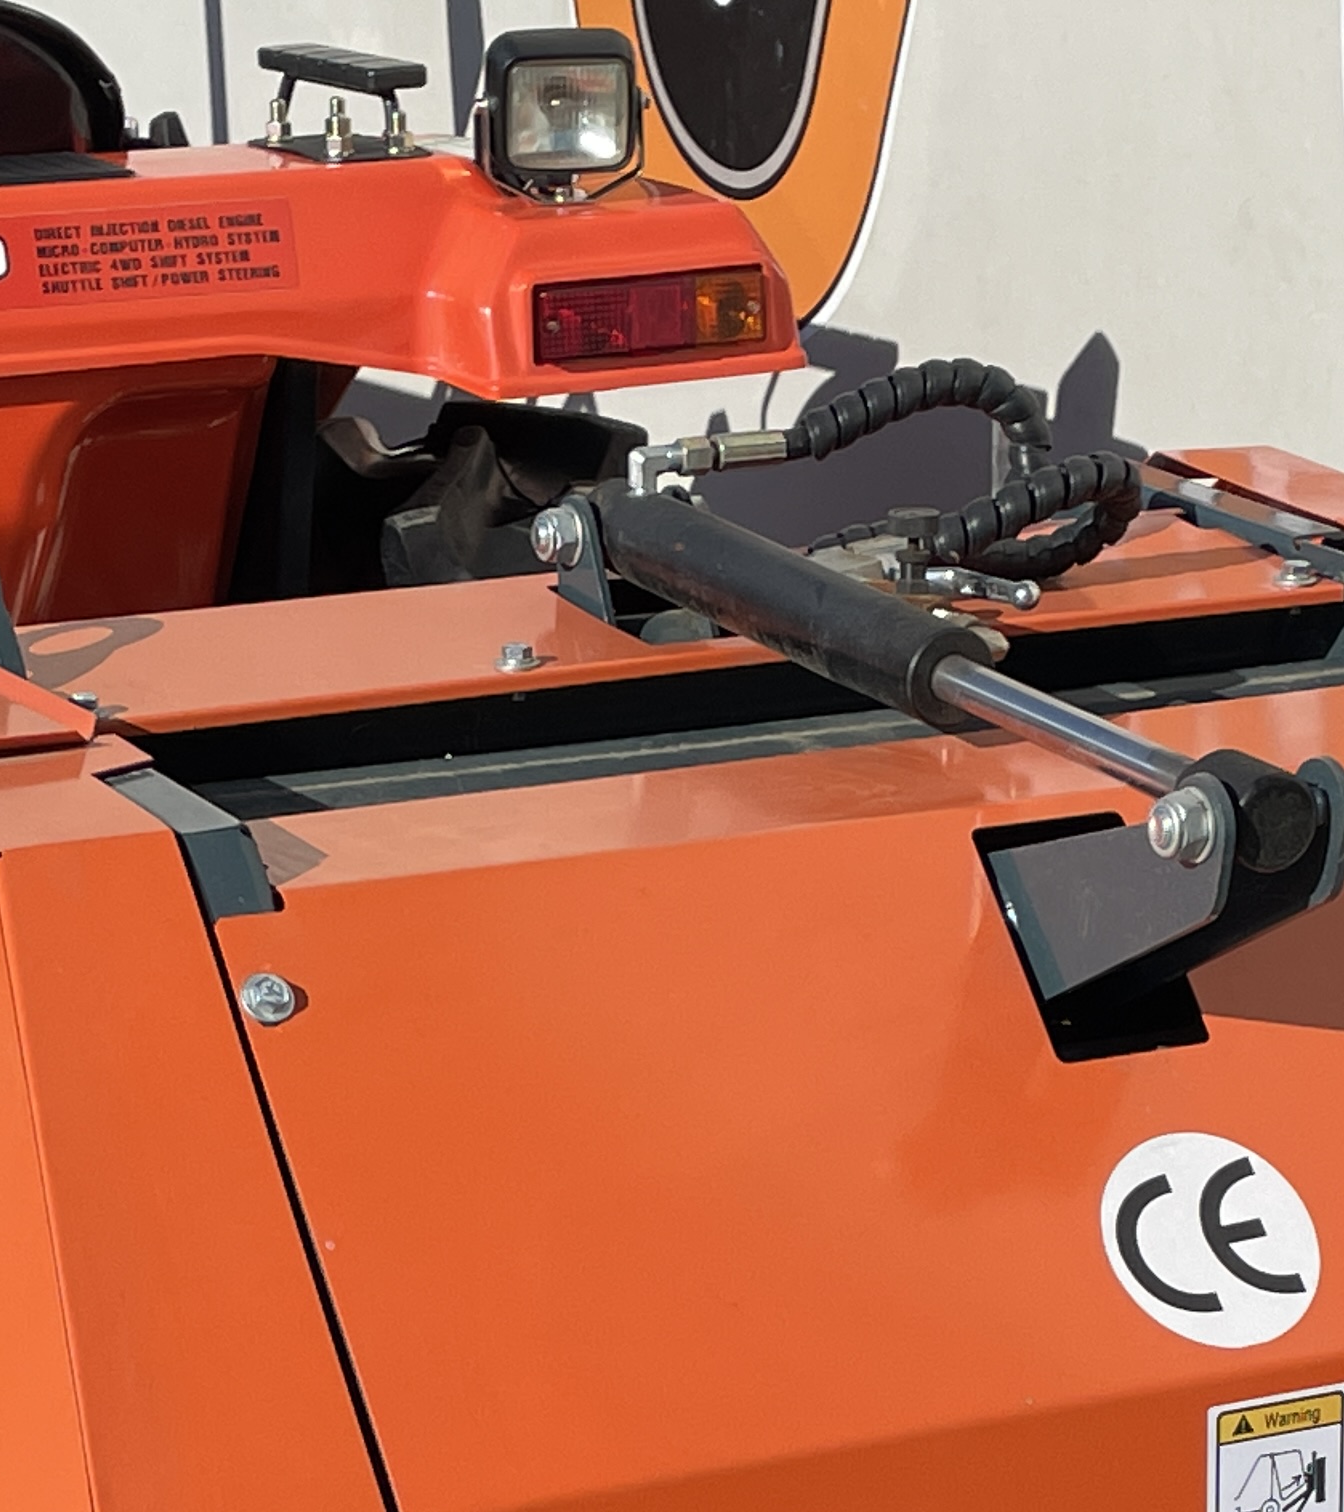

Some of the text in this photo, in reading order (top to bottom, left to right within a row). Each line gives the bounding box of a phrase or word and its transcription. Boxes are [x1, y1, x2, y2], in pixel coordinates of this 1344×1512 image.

[34, 213, 264, 241] DIRECT INJECTION DIESEL ENGINE
[227, 230, 280, 246] SYSTEM
[39, 249, 250, 277] ELECTRIC 4WD SHIFT SYSTEM
[42, 278, 103, 294] SHUTTLE
[218, 264, 280, 281] STEERING
[1115, 1156, 1306, 1312] CE
[1264, 1407, 1321, 1429] Warning
